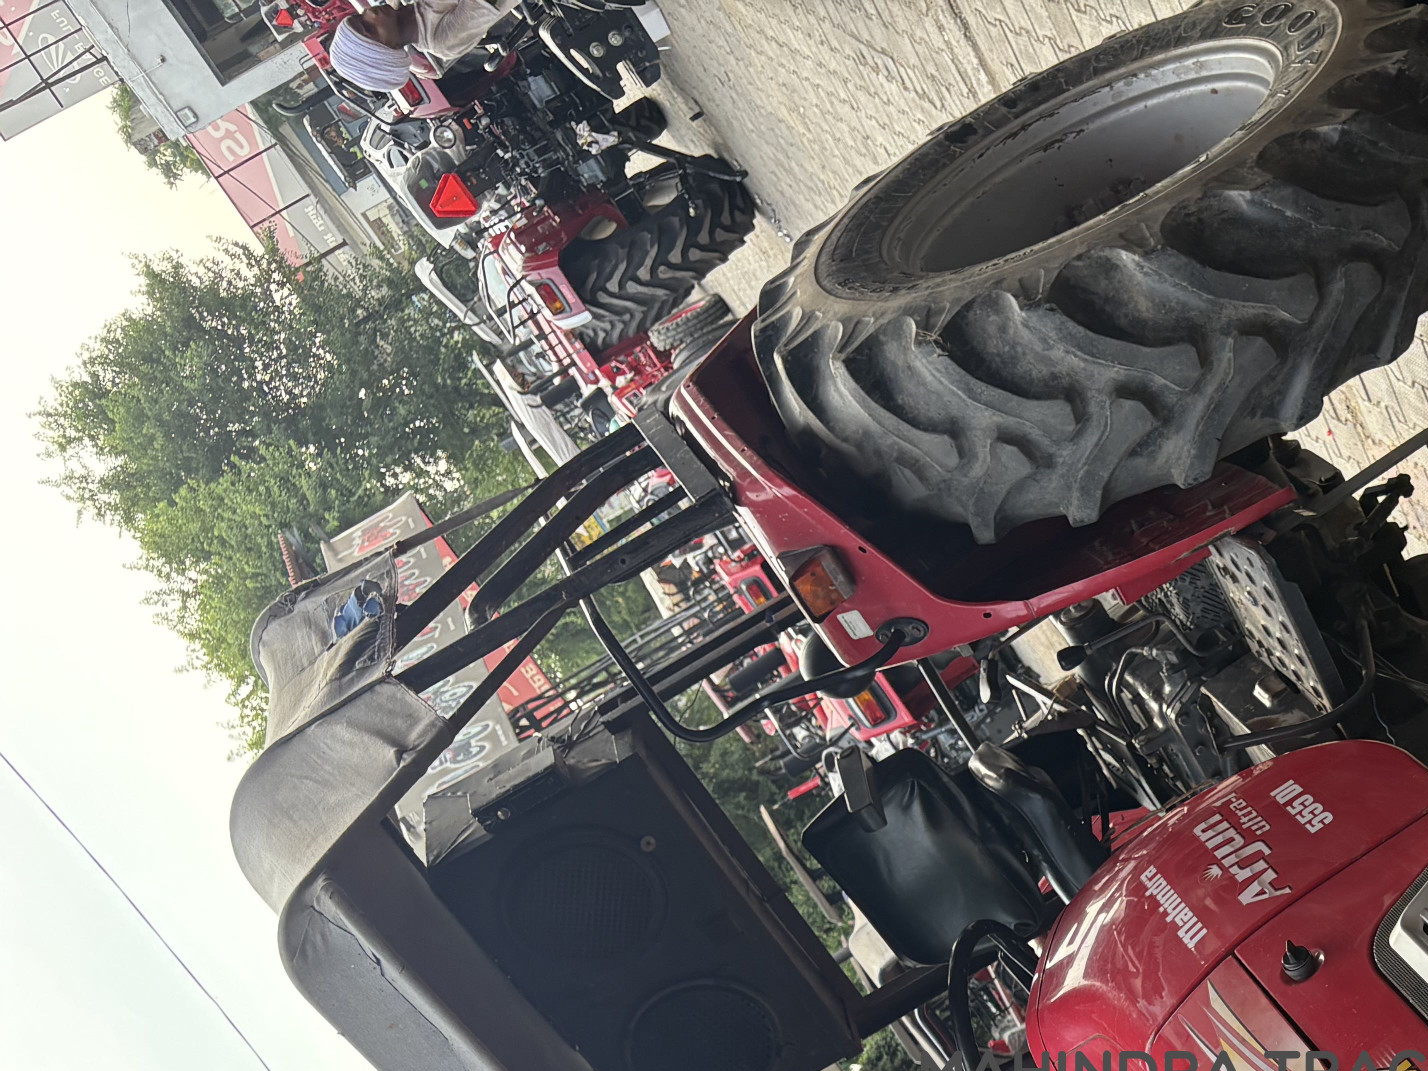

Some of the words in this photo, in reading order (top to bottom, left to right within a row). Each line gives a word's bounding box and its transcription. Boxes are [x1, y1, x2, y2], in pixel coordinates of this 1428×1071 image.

[1269, 779, 1304, 805] DI
[1285, 793, 1334, 834] 555
[1193, 812, 1293, 906] Arjun
[1139, 864, 1208, 950] Mahindra
